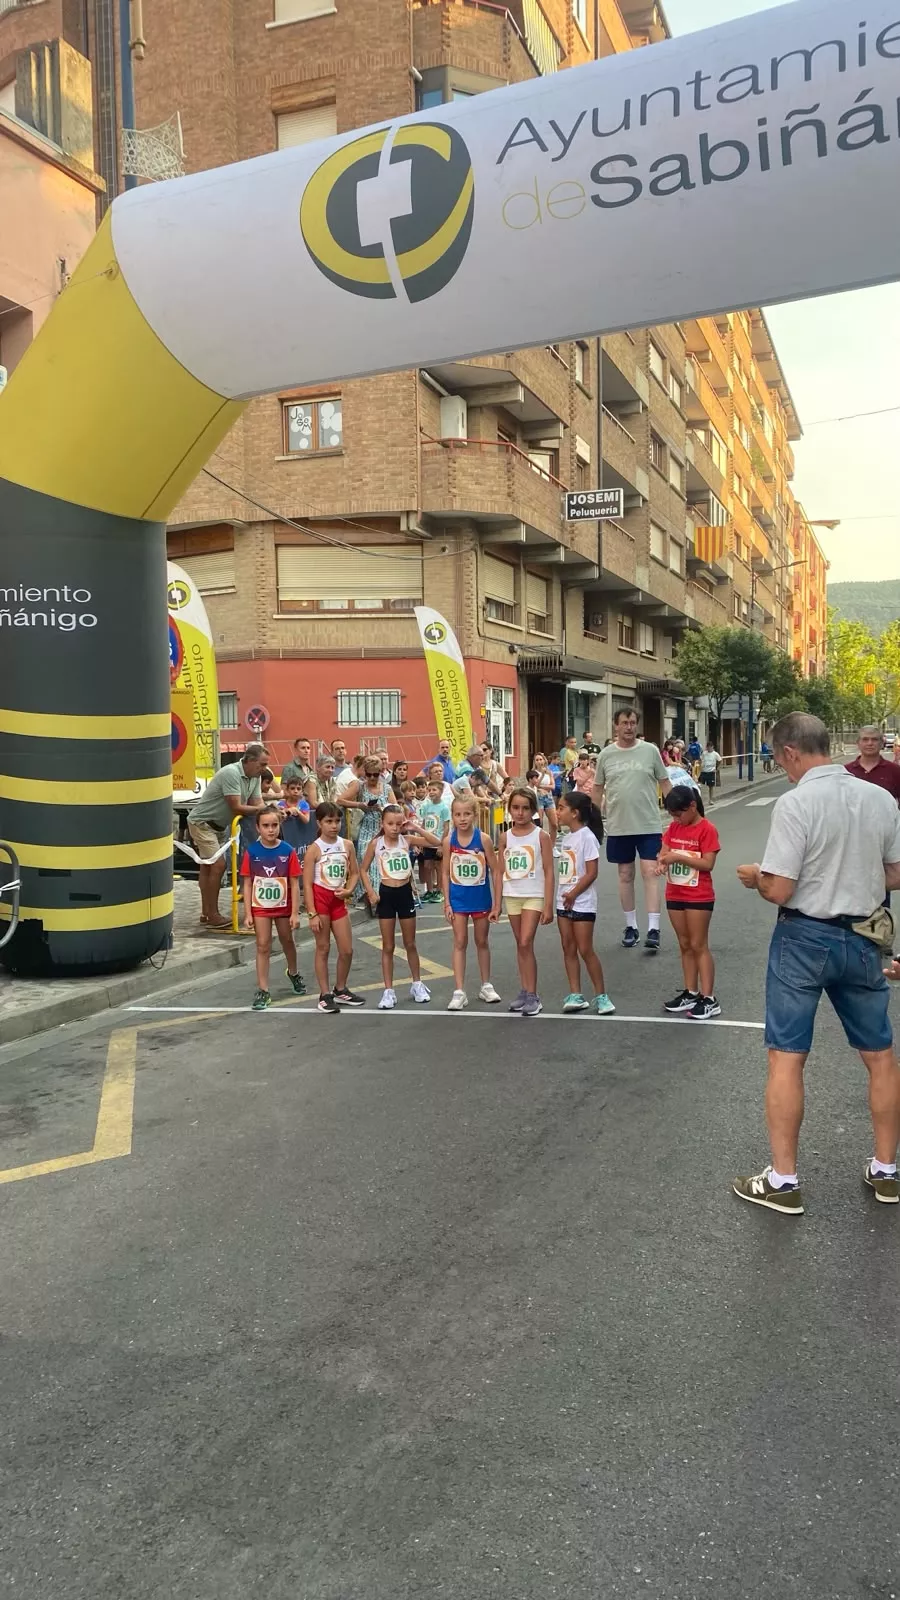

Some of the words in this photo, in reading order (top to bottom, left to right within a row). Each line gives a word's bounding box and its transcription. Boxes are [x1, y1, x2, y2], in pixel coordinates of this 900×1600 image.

[570, 491, 619, 505] JOSEMI
[570, 505, 618, 517] Peluquería
[387, 857, 409, 872] 160
[508, 856, 528, 871] 164
[327, 865, 345, 878] 195
[456, 864, 479, 877] 199
[258, 887, 281, 900] 200
